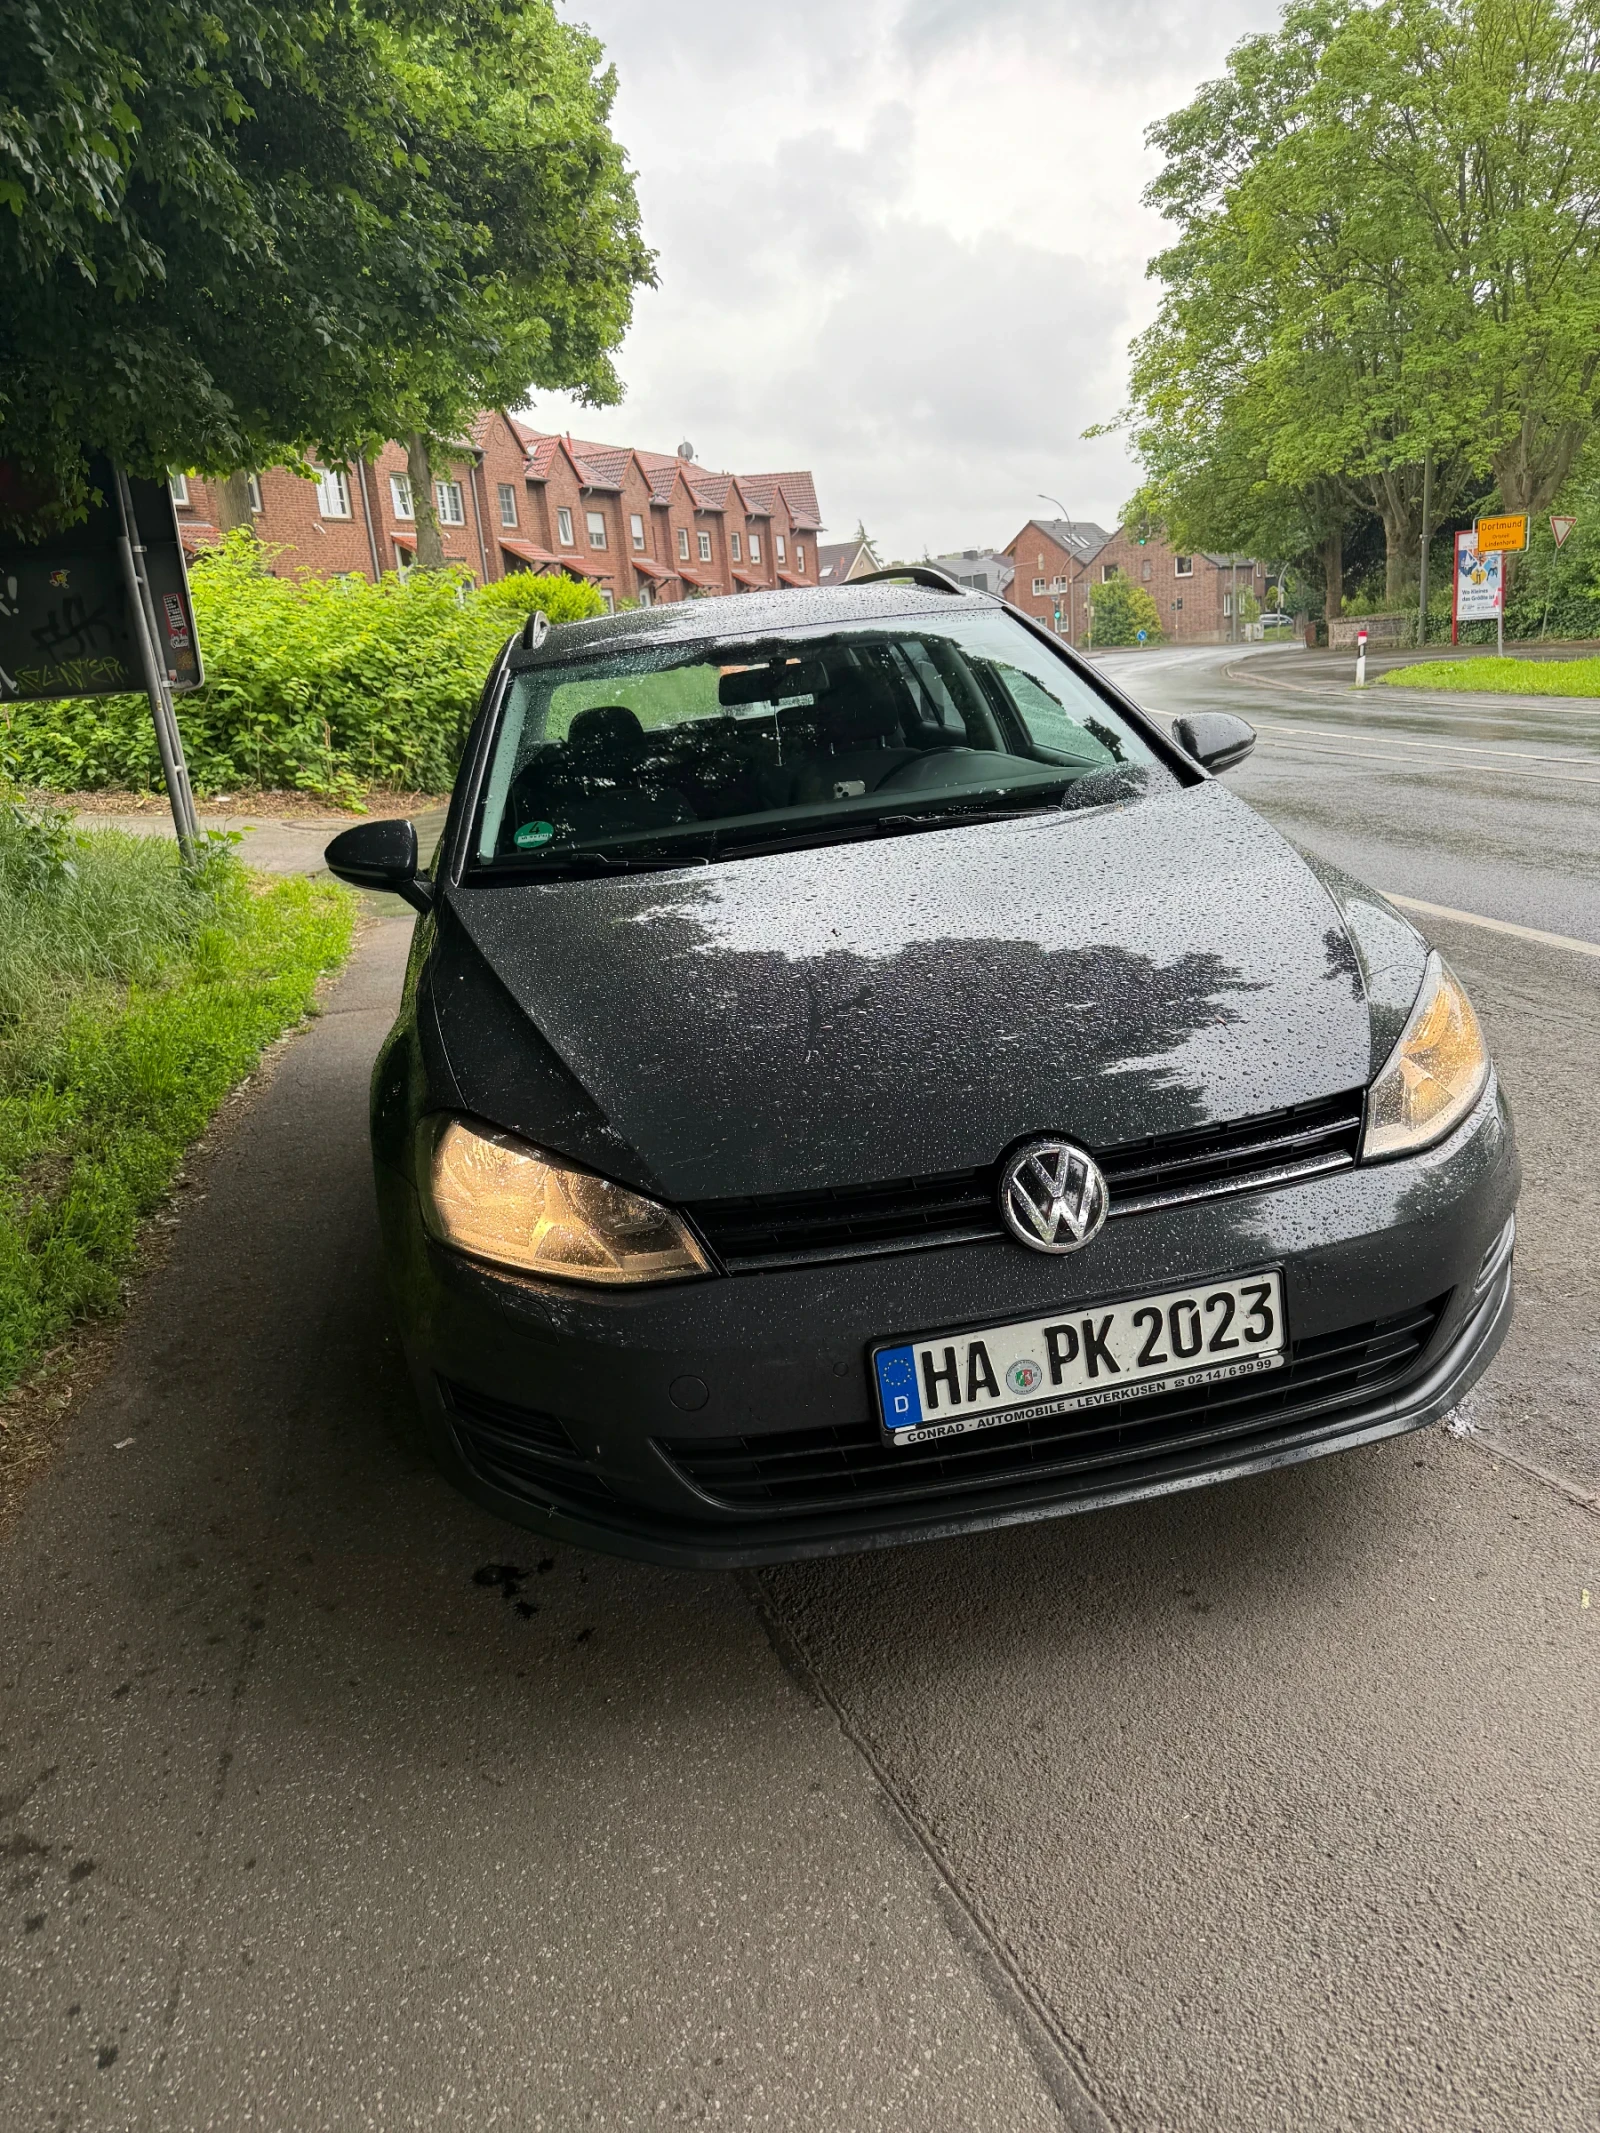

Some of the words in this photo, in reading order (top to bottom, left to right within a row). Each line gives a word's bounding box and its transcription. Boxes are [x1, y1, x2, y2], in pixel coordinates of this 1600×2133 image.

[1481, 519, 1522, 531] Dortmund
[1484, 539, 1517, 548] Lindenhorst
[528, 822, 540, 834] 4
[1006, 1145, 1101, 1248] VW
[921, 1340, 1001, 1409] HA
[1043, 1313, 1121, 1385] PK
[1133, 1282, 1274, 1368] 2023
[894, 1396, 909, 1413] D
[907, 1422, 965, 1442] CONRAD
[977, 1402, 1066, 1429] AUTOMOBILE
[1077, 1381, 1166, 1408] LEVERKUSEN
